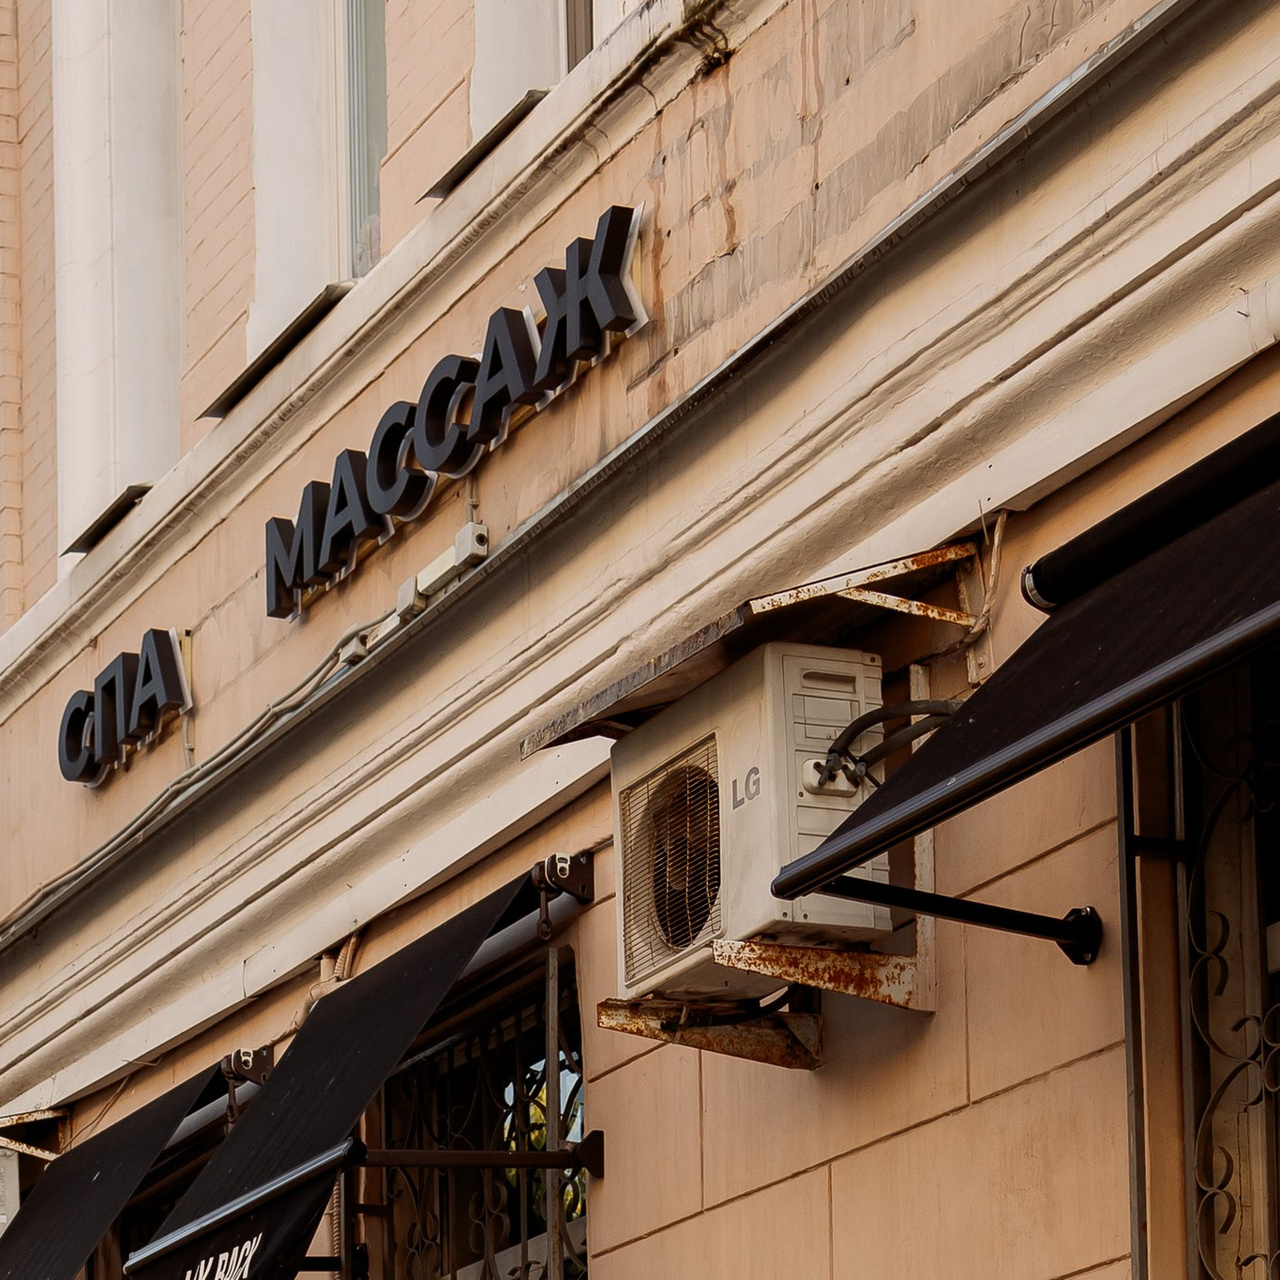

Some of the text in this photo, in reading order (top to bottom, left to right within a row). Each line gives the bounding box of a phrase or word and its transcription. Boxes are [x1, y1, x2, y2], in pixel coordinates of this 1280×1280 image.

[58, 203, 646, 784] СПА МАССАЖ
[731, 766, 761, 810] LG
